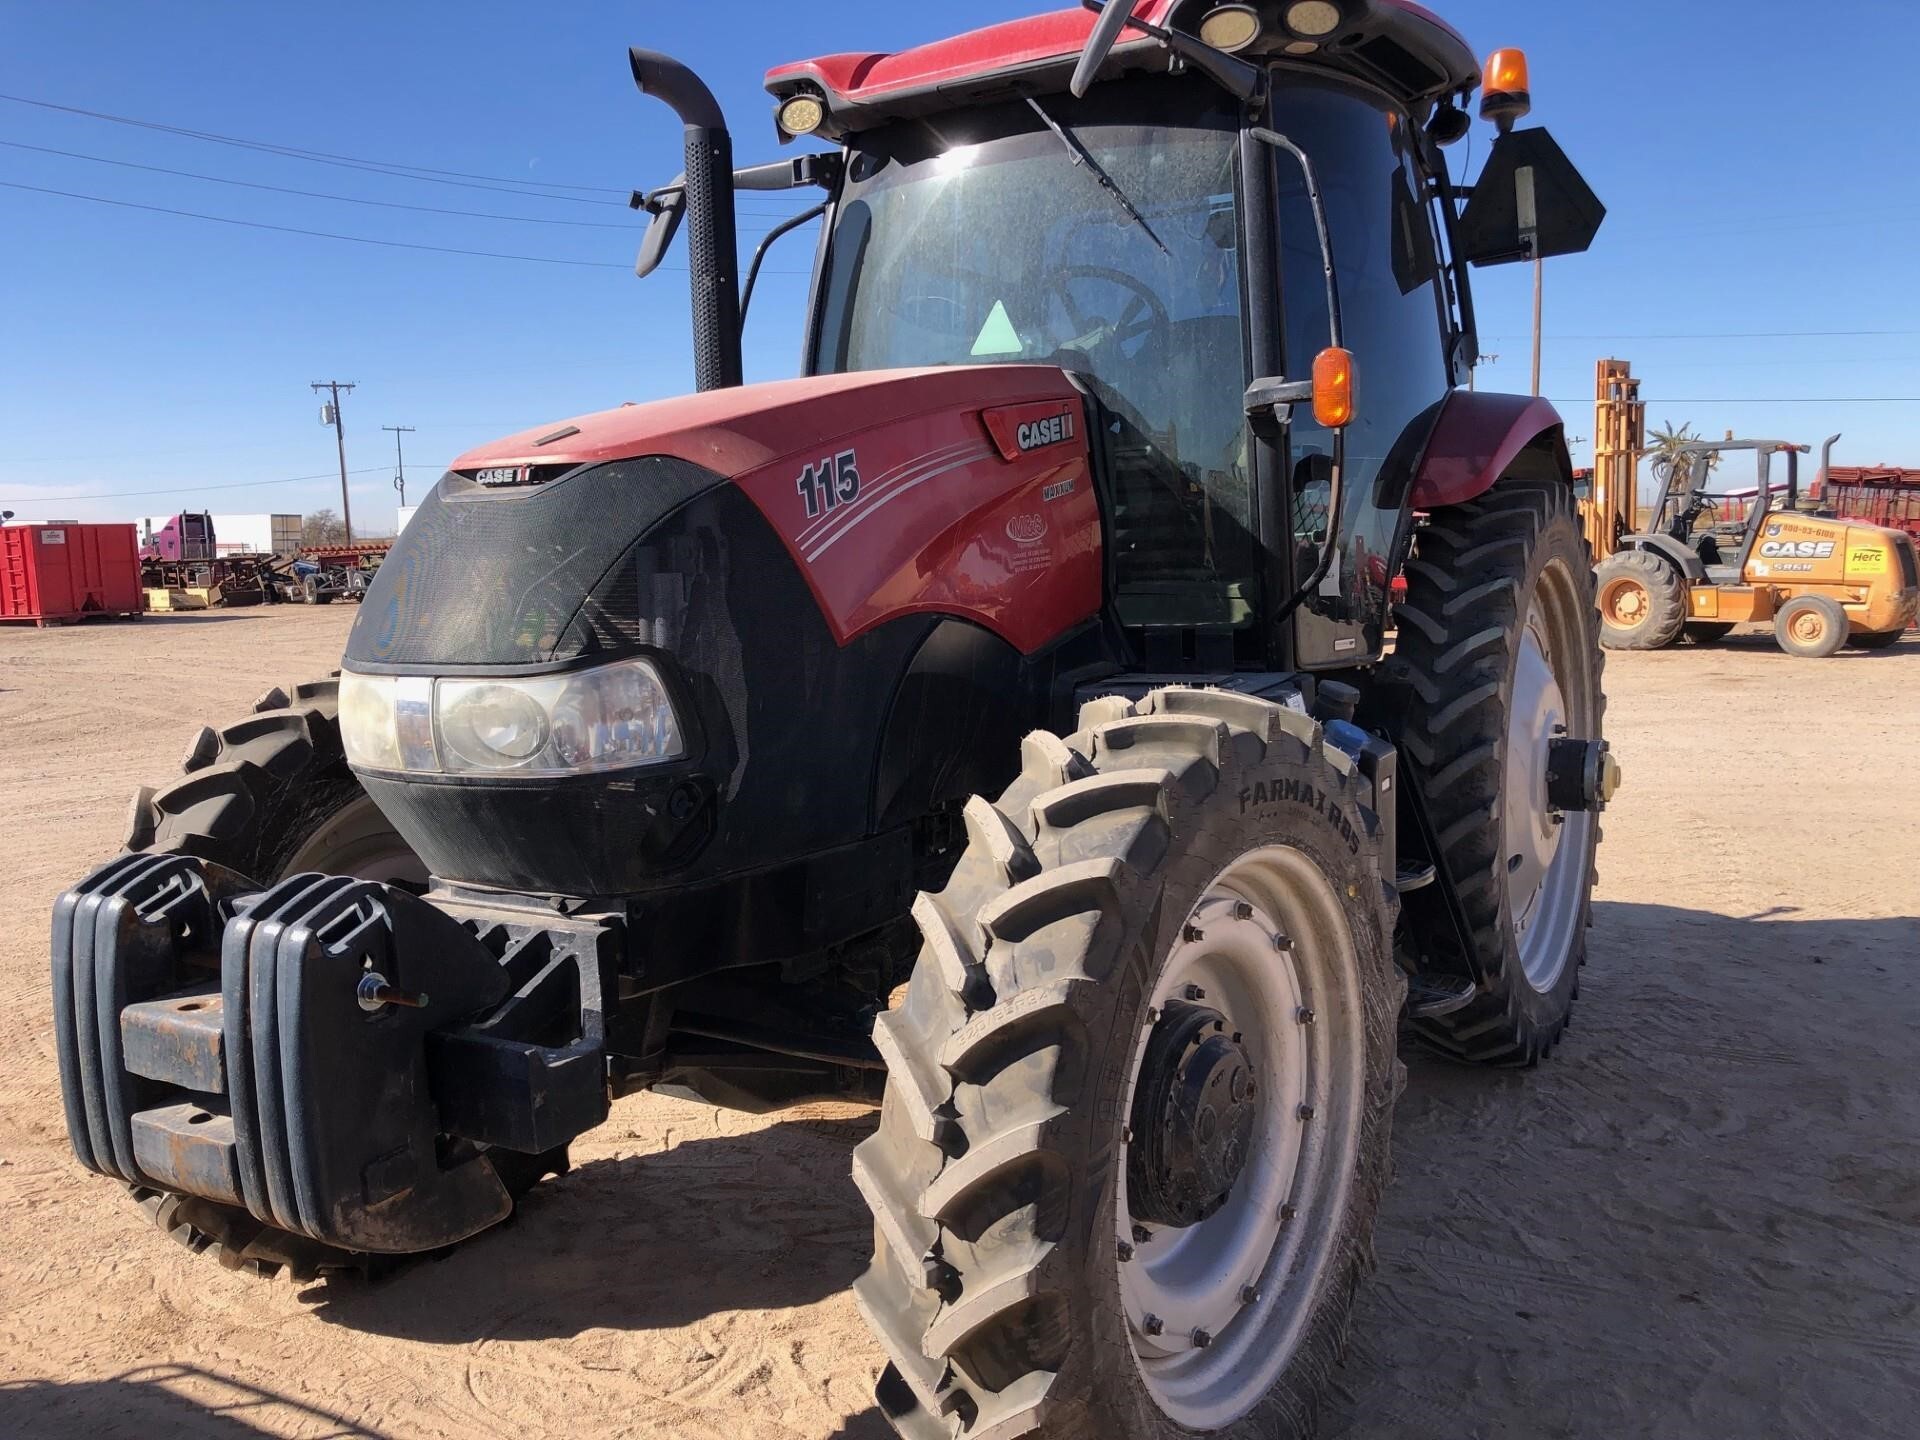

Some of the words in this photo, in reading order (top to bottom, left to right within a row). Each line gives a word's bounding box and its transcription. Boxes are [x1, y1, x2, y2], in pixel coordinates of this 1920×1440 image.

[1017, 416, 1061, 450] CASE
[476, 468, 514, 484] CASE
[796, 448, 861, 519] 115
[1760, 541, 1835, 558] CASE
[1852, 552, 1882, 562] Herc
[1239, 778, 1326, 815] FARMAX
